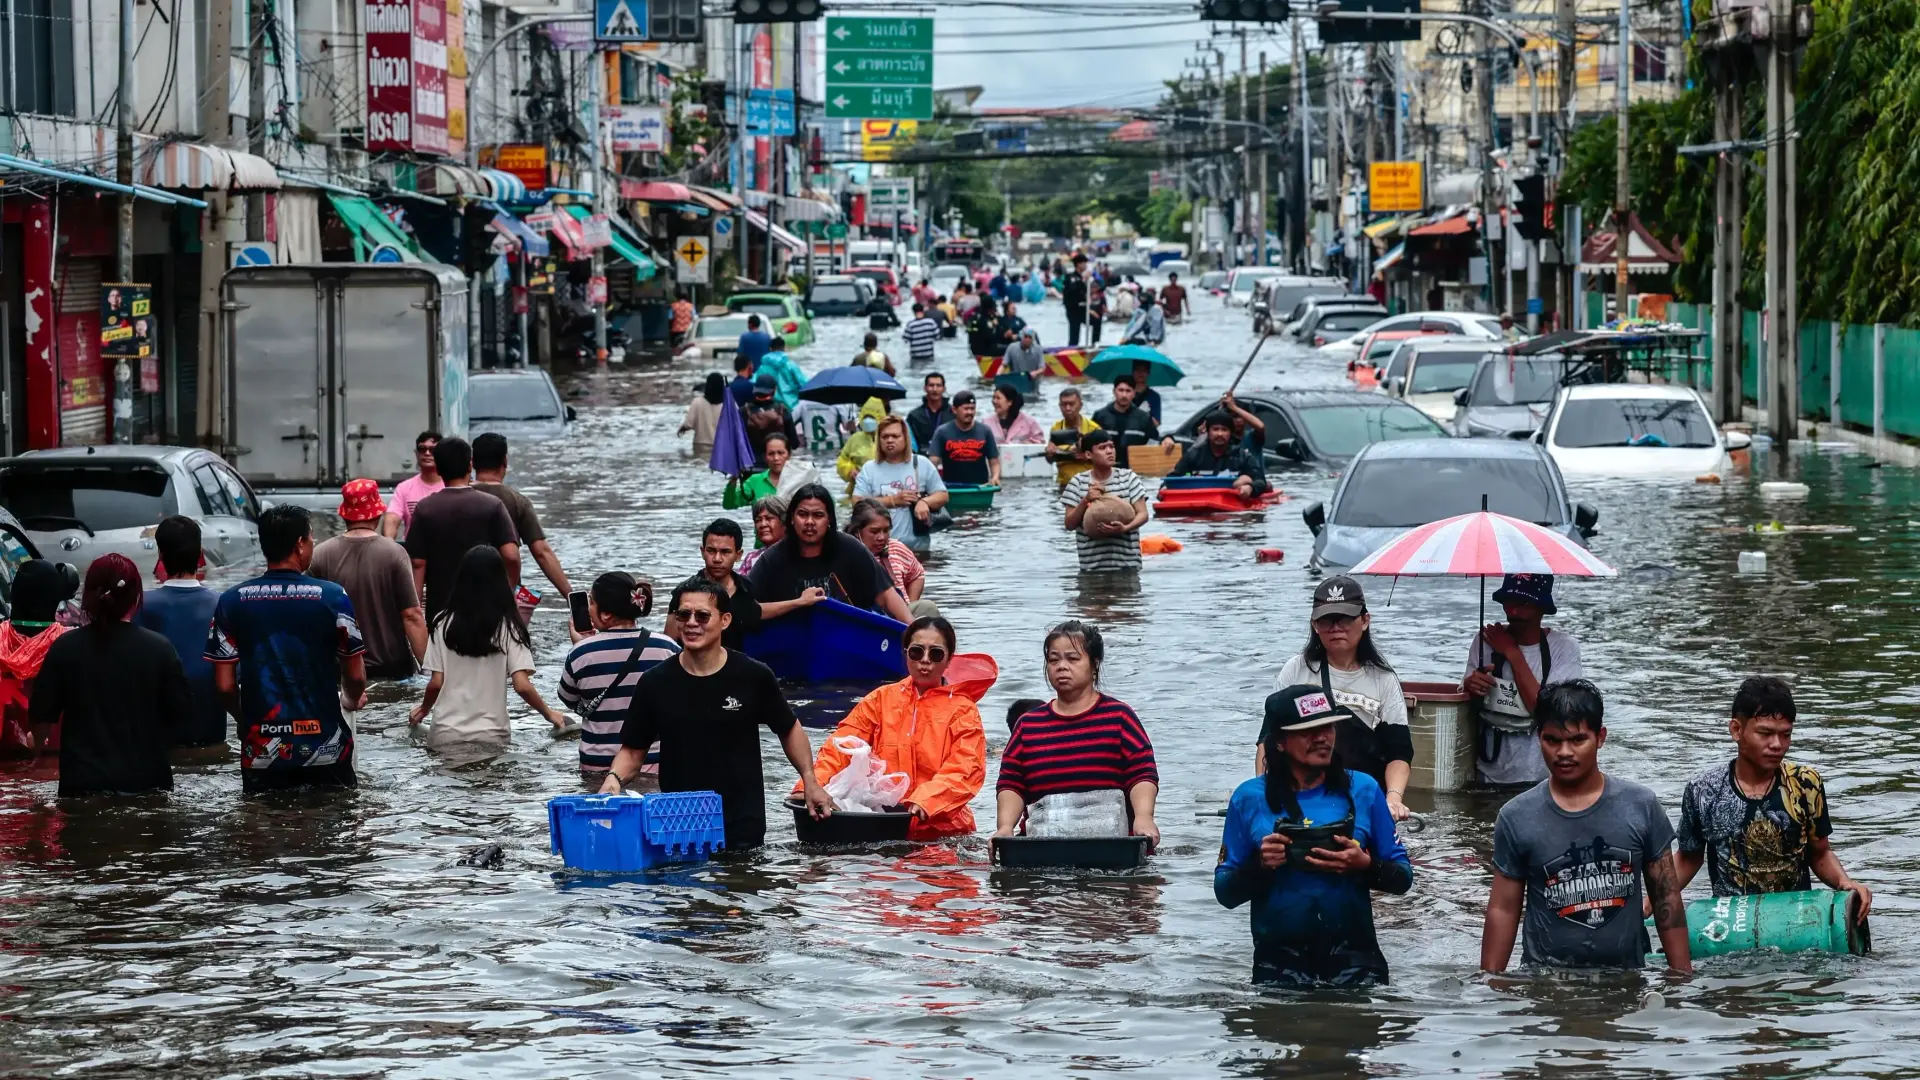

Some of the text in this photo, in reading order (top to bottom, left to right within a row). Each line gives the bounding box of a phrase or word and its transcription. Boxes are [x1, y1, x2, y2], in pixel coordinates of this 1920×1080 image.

[864, 20, 917, 36] ร่มเกล้า
[369, 46, 409, 98] มุ้งลวด
[857, 55, 925, 71] ลาดกระบัง
[871, 88, 913, 109] มีนบุรี
[369, 111, 409, 141] กระจก
[135, 302, 148, 313] 12
[812, 416, 828, 442] 6
[1497, 698, 1519, 709] adida
[1557, 860, 1622, 881] STATE
[1543, 873, 1635, 909] CHAMPIONSHIPS
[1574, 902, 1592, 911] TRACK
[1600, 899, 1613, 907] FIELD
